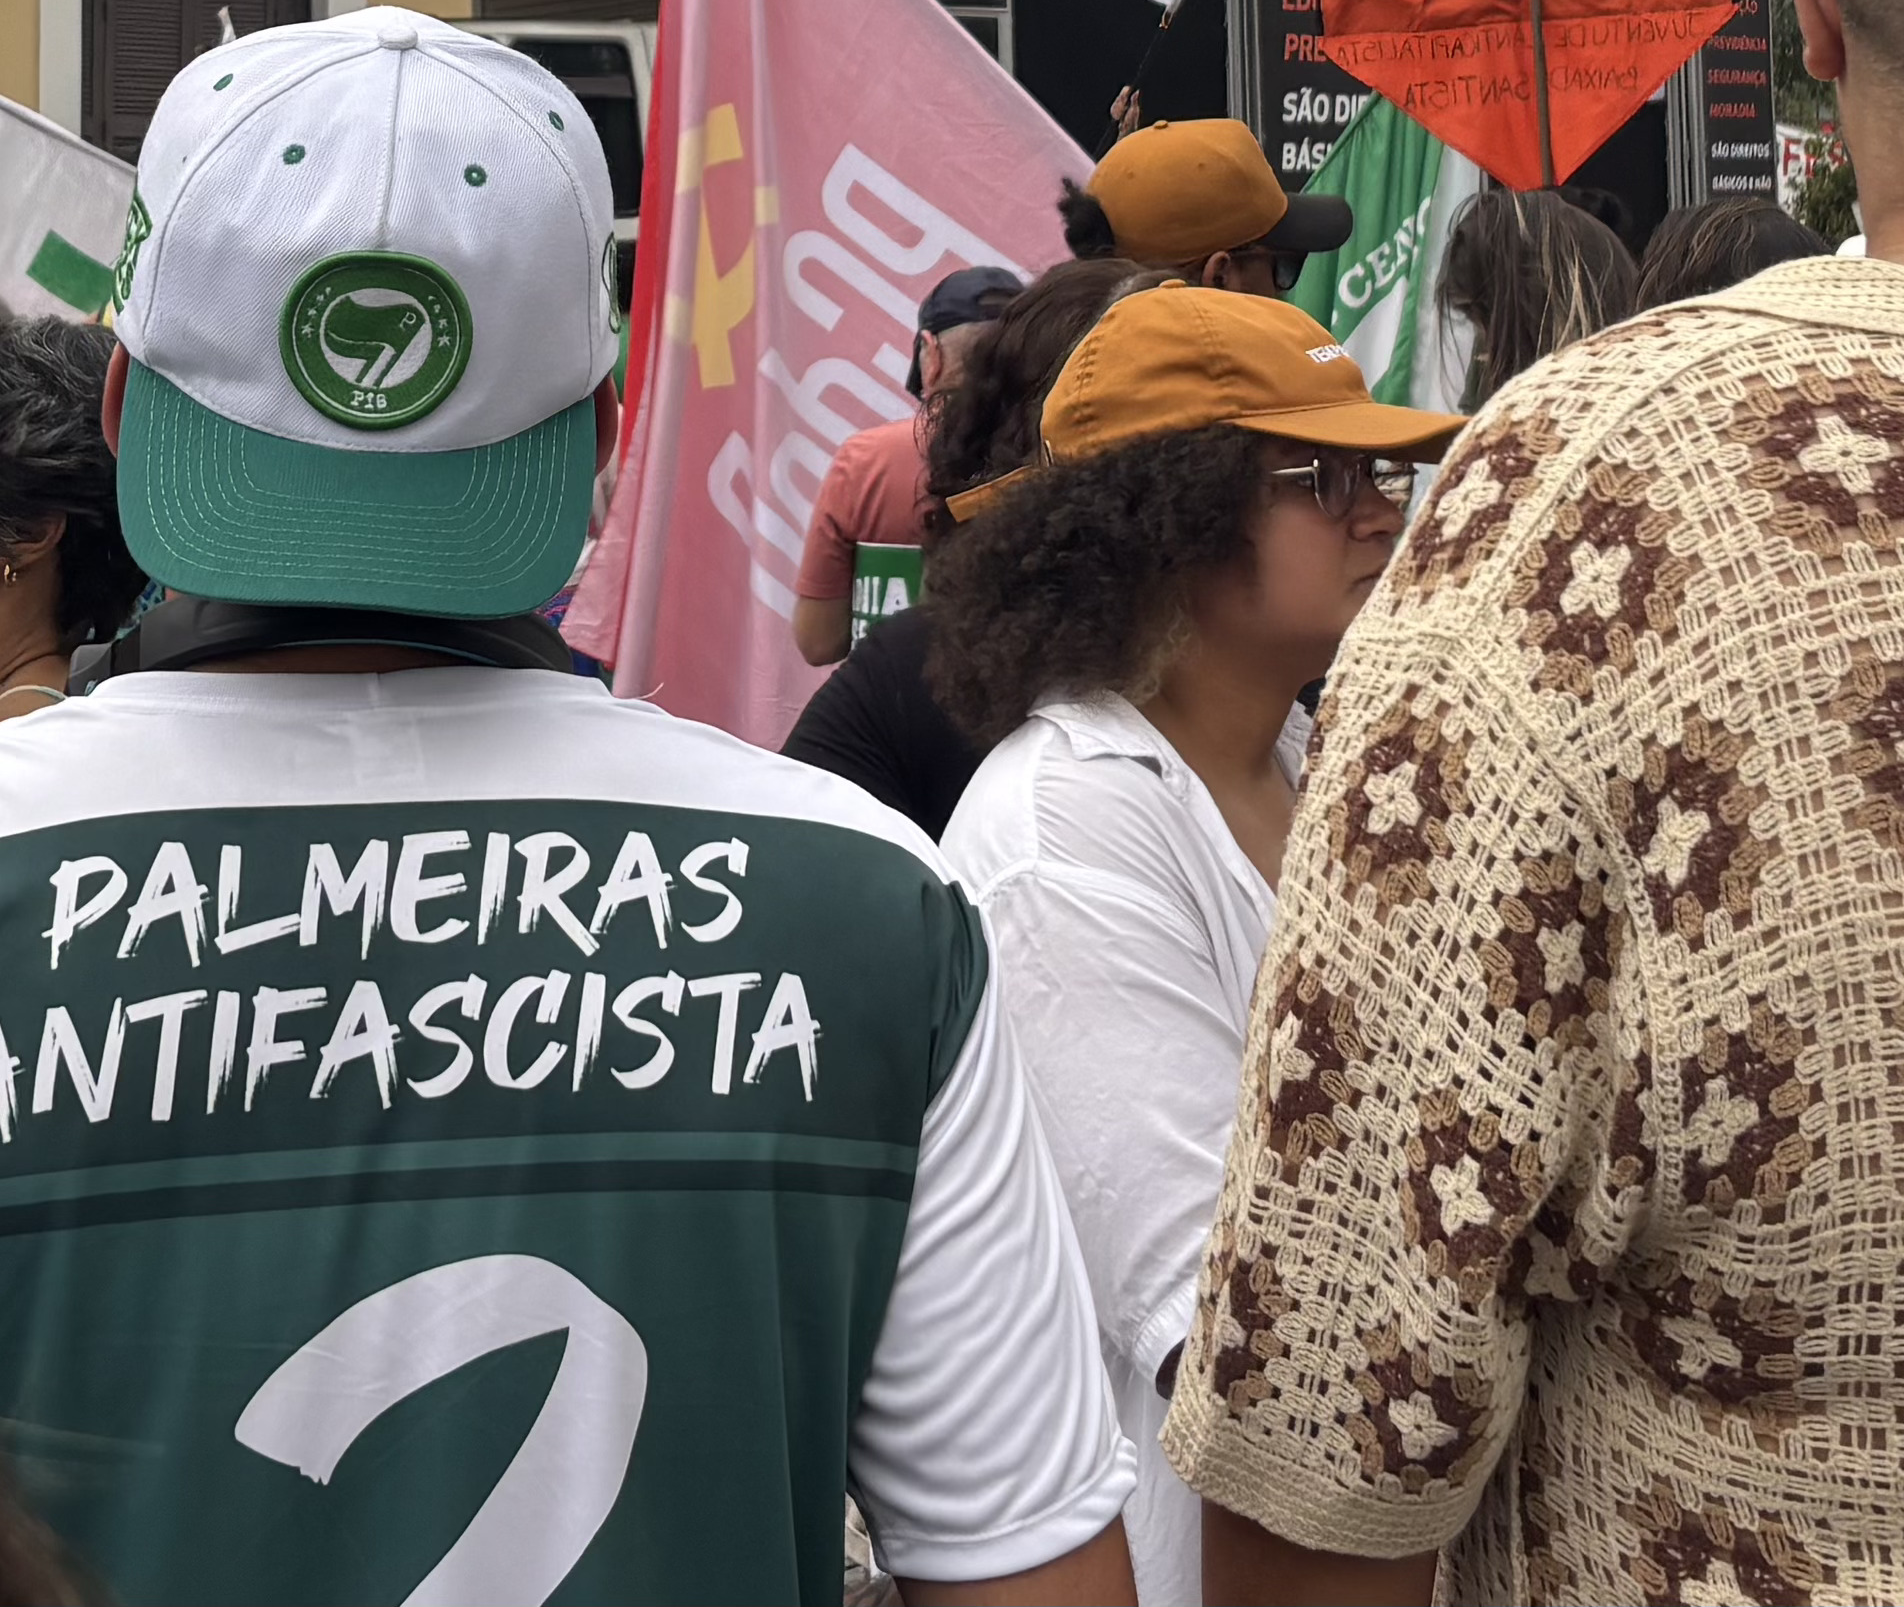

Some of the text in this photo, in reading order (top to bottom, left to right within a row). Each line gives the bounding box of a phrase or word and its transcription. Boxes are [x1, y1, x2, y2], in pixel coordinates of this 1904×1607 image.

[1708, 69, 1767, 88] SEGURANÇA
[1282, 86, 1329, 123] SÃO
[1712, 140, 1729, 158] SÃO
[1730, 142, 1770, 159] DIREITOS
[41, 830, 749, 969] PALMEIRAS
